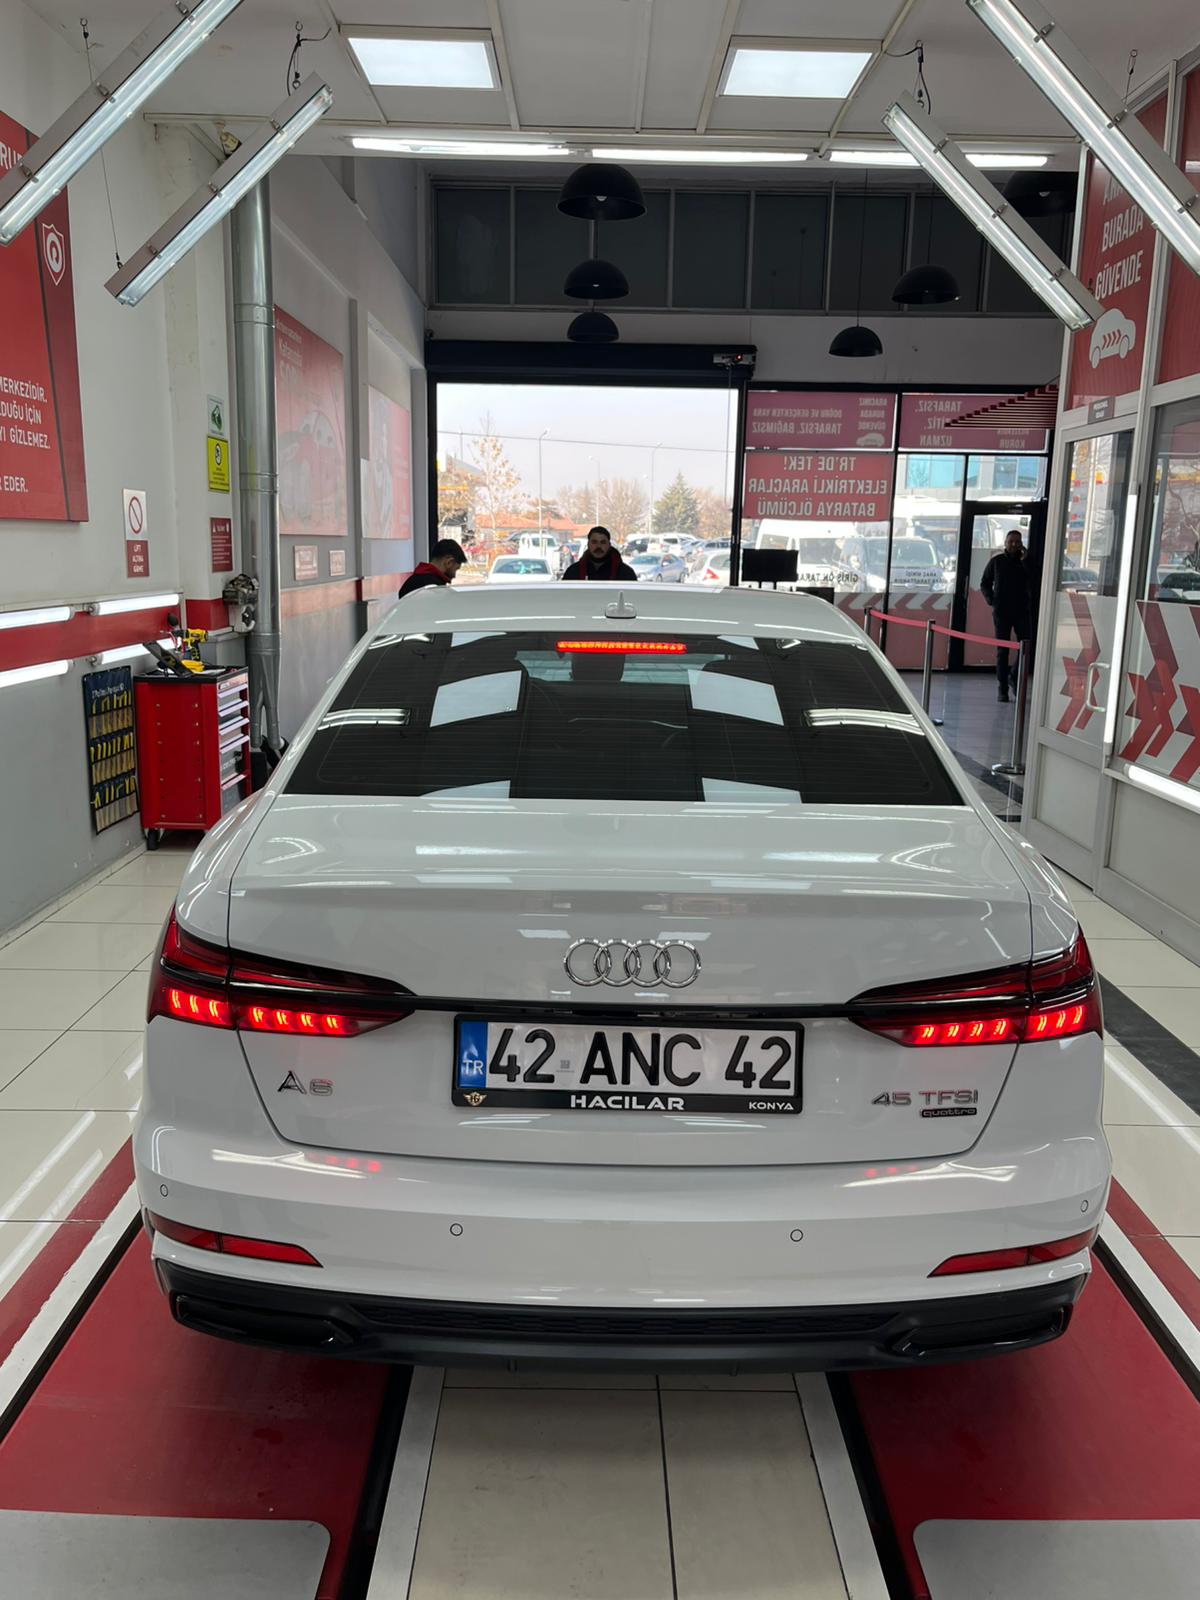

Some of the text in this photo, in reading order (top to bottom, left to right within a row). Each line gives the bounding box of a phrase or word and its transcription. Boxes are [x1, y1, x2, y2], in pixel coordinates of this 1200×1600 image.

[1101, 204, 1143, 253] BURADA
[1095, 249, 1144, 301] GÜVENDE
[0, 400, 41, 425] DUĞU İÇİN
[10, 424, 51, 449] GİZLEMEZ.
[4, 475, 29, 492] EDER.
[462, 1060, 484, 1075] TR
[489, 1028, 792, 1089] 42 ANC 42
[277, 1070, 333, 1096] A6
[570, 1094, 685, 1111] HACILAR
[748, 1101, 794, 1110] KONYA
[871, 1089, 978, 1106] 45 TFSI
[922, 1109, 976, 1118] quattro
